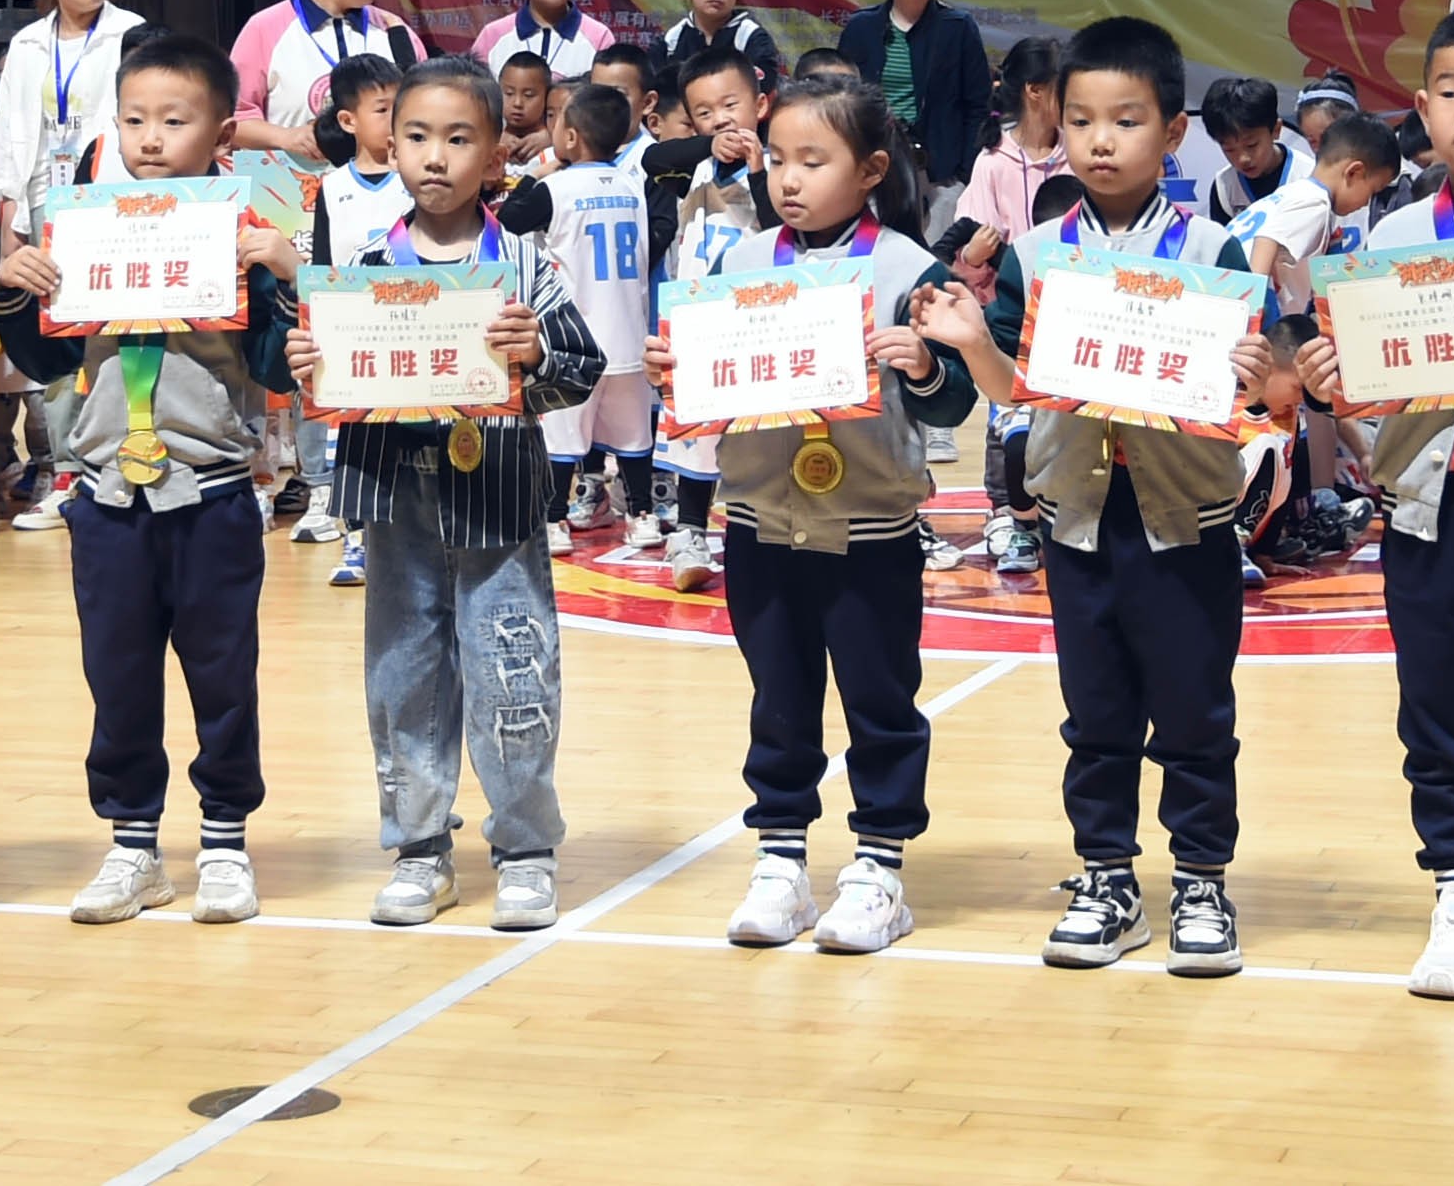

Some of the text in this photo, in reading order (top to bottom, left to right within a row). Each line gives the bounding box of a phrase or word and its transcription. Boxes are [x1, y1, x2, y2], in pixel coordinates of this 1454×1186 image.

[585, 221, 639, 281] 18
[88, 260, 190, 291] 优胜奖
[351, 348, 460, 379] 优胜奖
[712, 348, 817, 388] 优胜奖
[1073, 335, 1189, 385] 优胜奖
